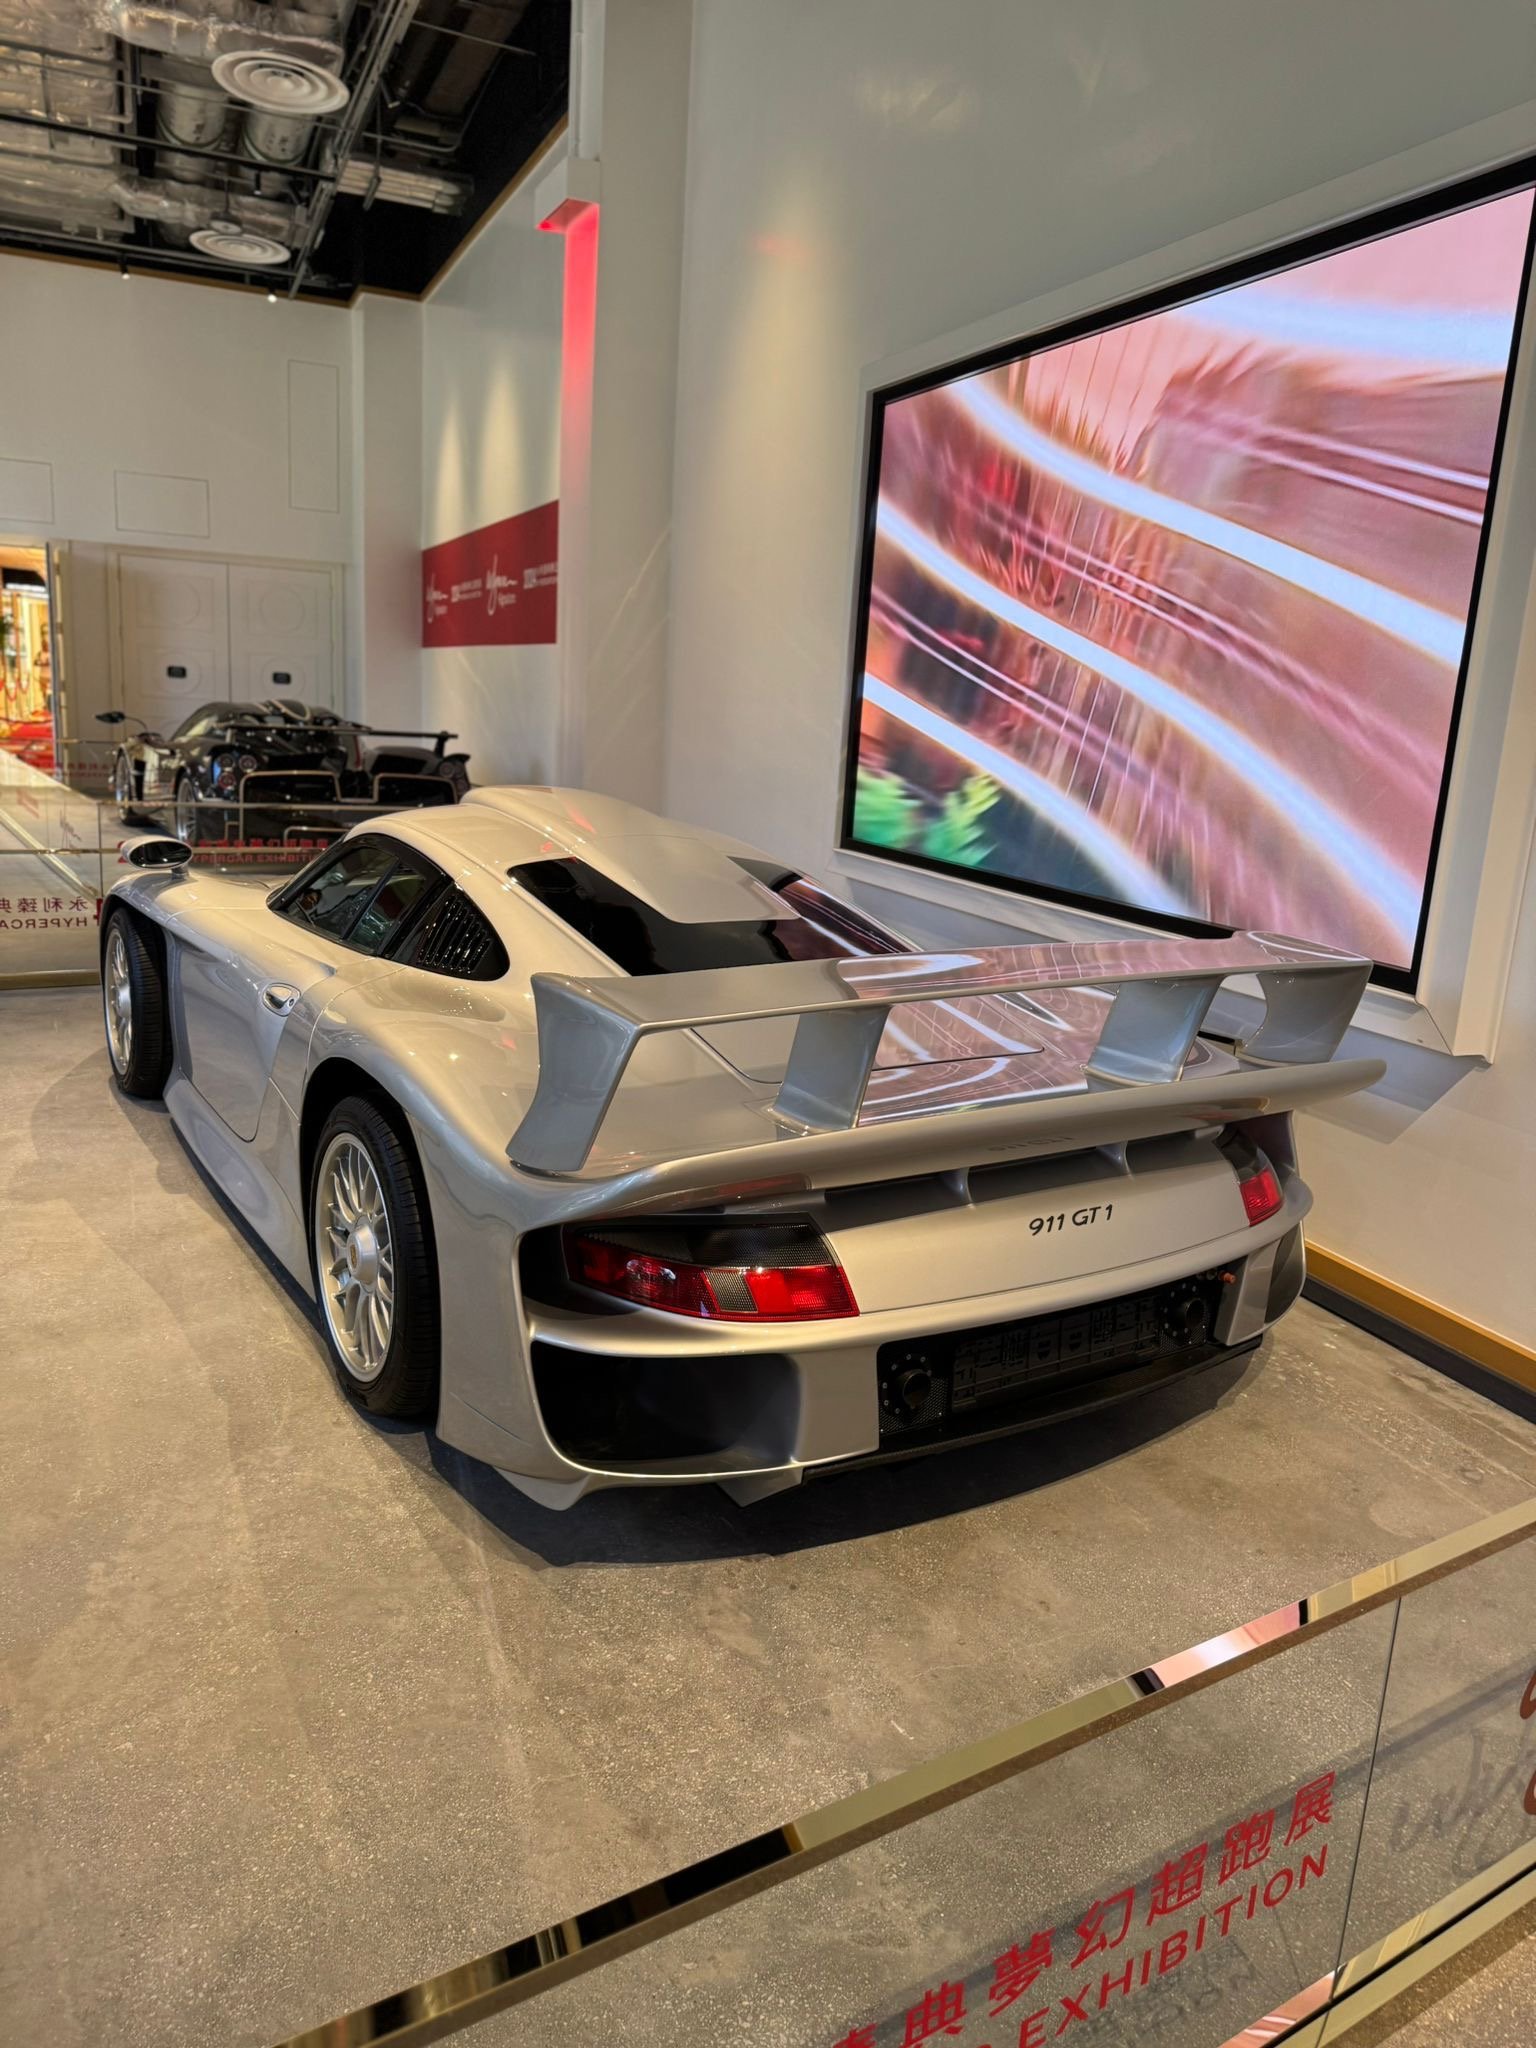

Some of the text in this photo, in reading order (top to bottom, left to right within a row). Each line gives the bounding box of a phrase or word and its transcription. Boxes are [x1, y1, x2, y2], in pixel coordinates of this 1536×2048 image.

[189, 853, 254, 864] YPERCAR
[1029, 1213, 1065, 1236] 911
[1018, 1843, 1329, 2048] EXHIBITION
